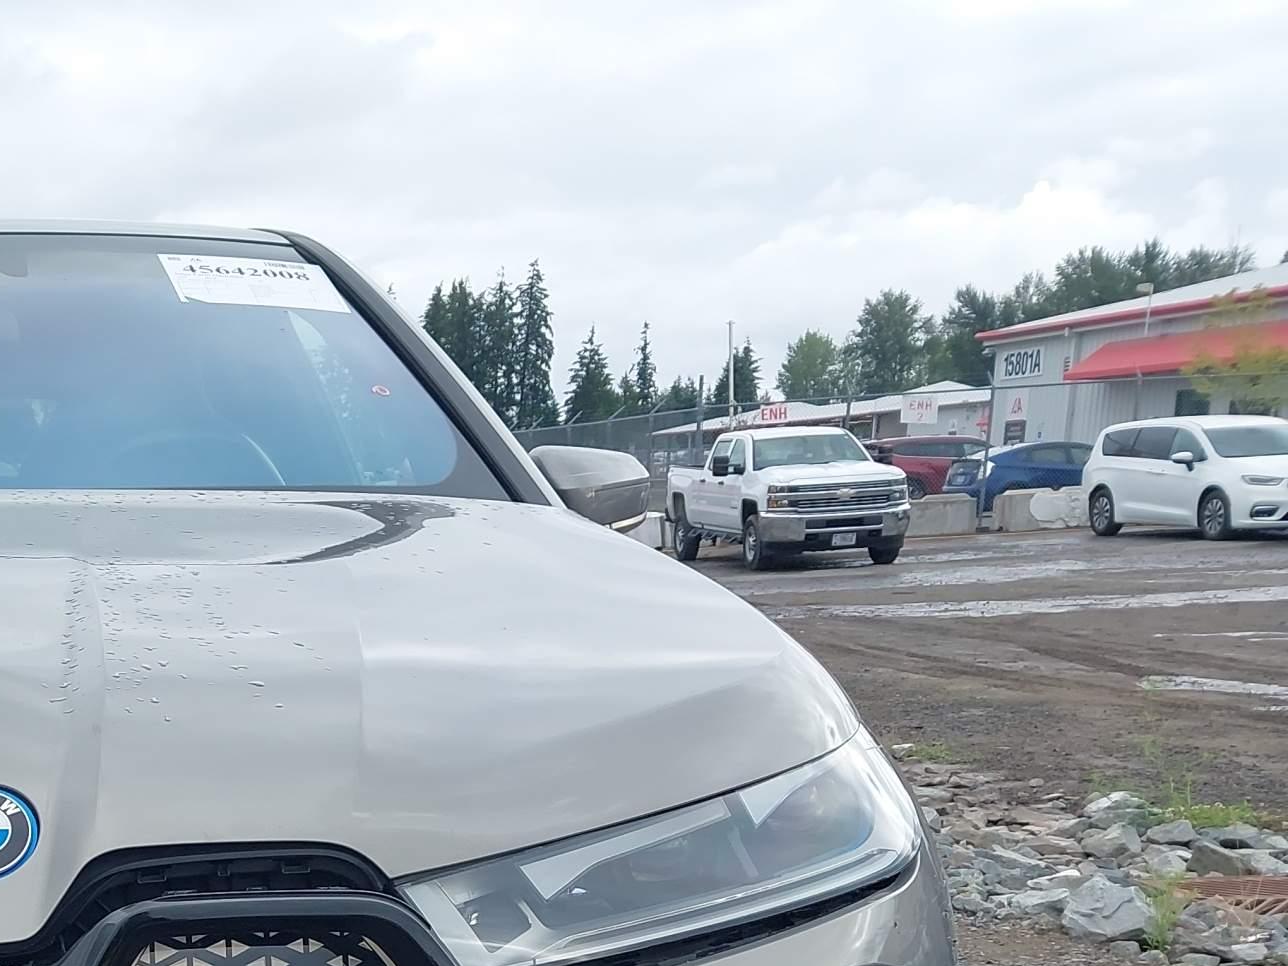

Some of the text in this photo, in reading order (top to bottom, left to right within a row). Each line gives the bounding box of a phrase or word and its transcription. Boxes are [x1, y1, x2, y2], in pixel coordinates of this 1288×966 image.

[182, 264, 311, 282] 45642008
[1003, 349, 1041, 377] 15801A
[909, 400, 932, 410] ENH
[761, 406, 788, 422] ENH
